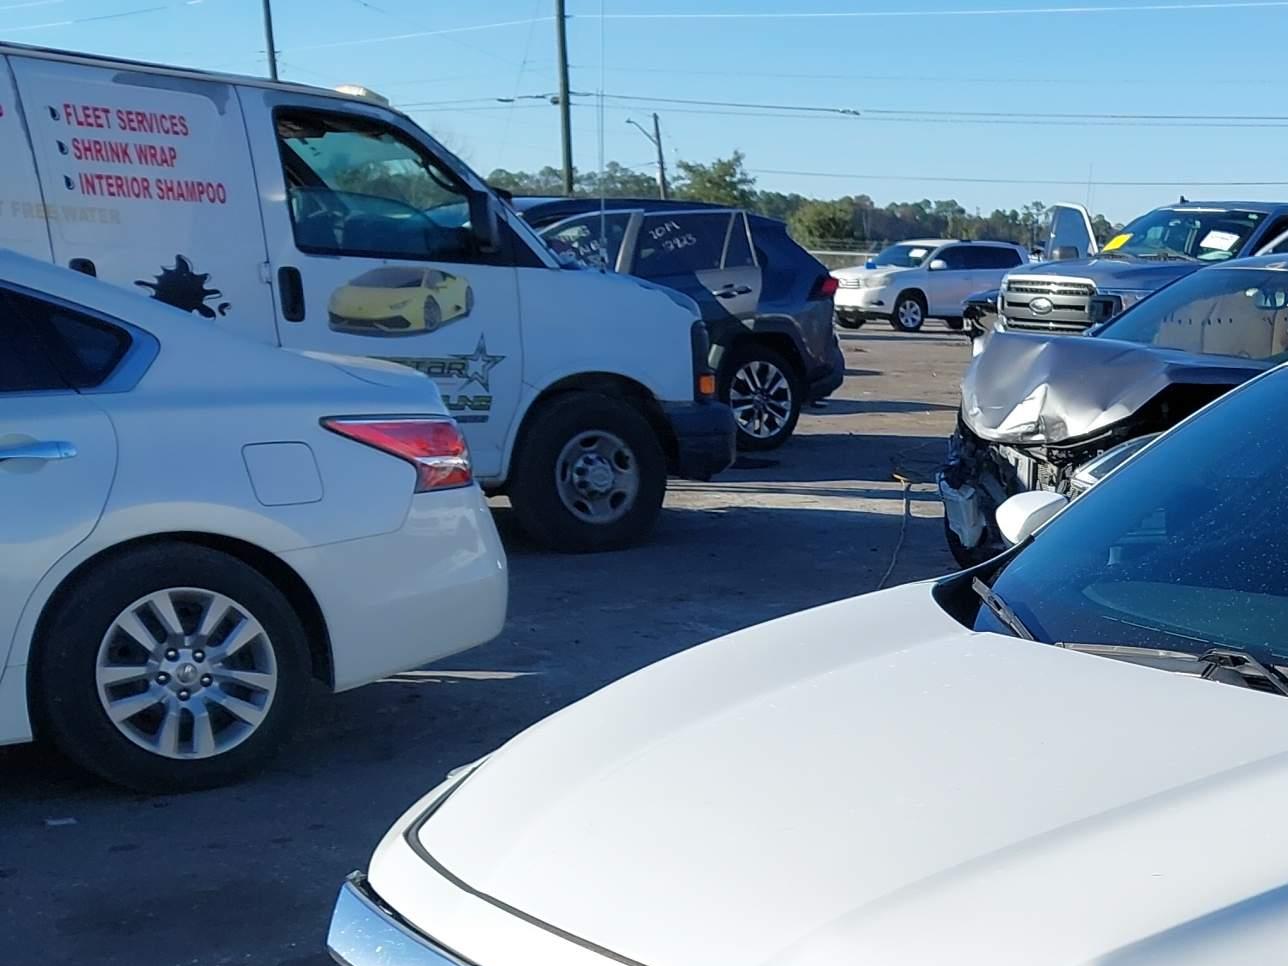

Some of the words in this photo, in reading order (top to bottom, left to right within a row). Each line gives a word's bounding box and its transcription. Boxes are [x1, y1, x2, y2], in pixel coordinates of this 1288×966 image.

[63, 103, 112, 129] FLEET
[117, 109, 189, 136] SERVICES
[71, 137, 133, 165] SHRINK
[134, 143, 177, 168] WRAP
[78, 172, 152, 199] INTERIOR
[155, 179, 227, 204] SHAMPOO
